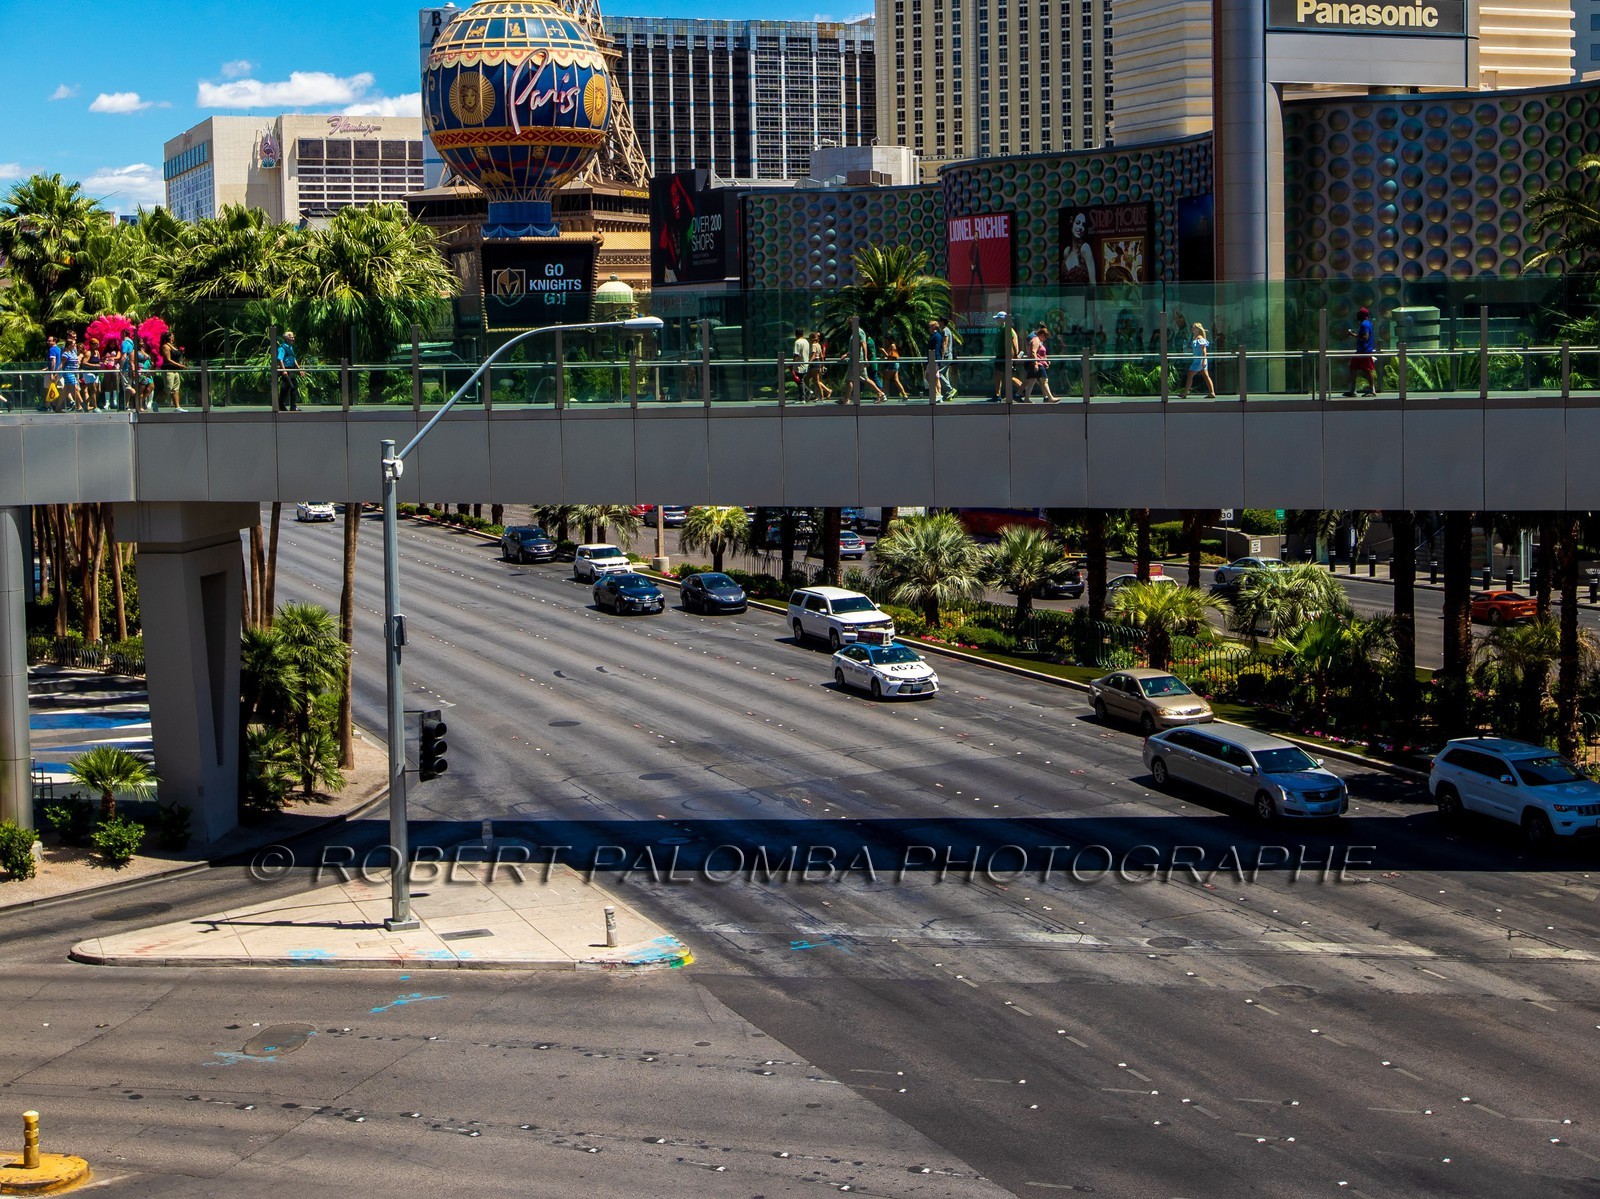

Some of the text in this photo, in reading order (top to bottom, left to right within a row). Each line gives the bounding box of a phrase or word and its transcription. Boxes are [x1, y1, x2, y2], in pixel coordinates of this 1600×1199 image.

[508, 47, 581, 135] Paris
[692, 213, 721, 234] OVER 200
[949, 215, 1009, 242] LIONEL RICHIE
[692, 232, 714, 252] SHOPS
[544, 263, 564, 277] GO
[529, 278, 582, 291] KNIGHTS
